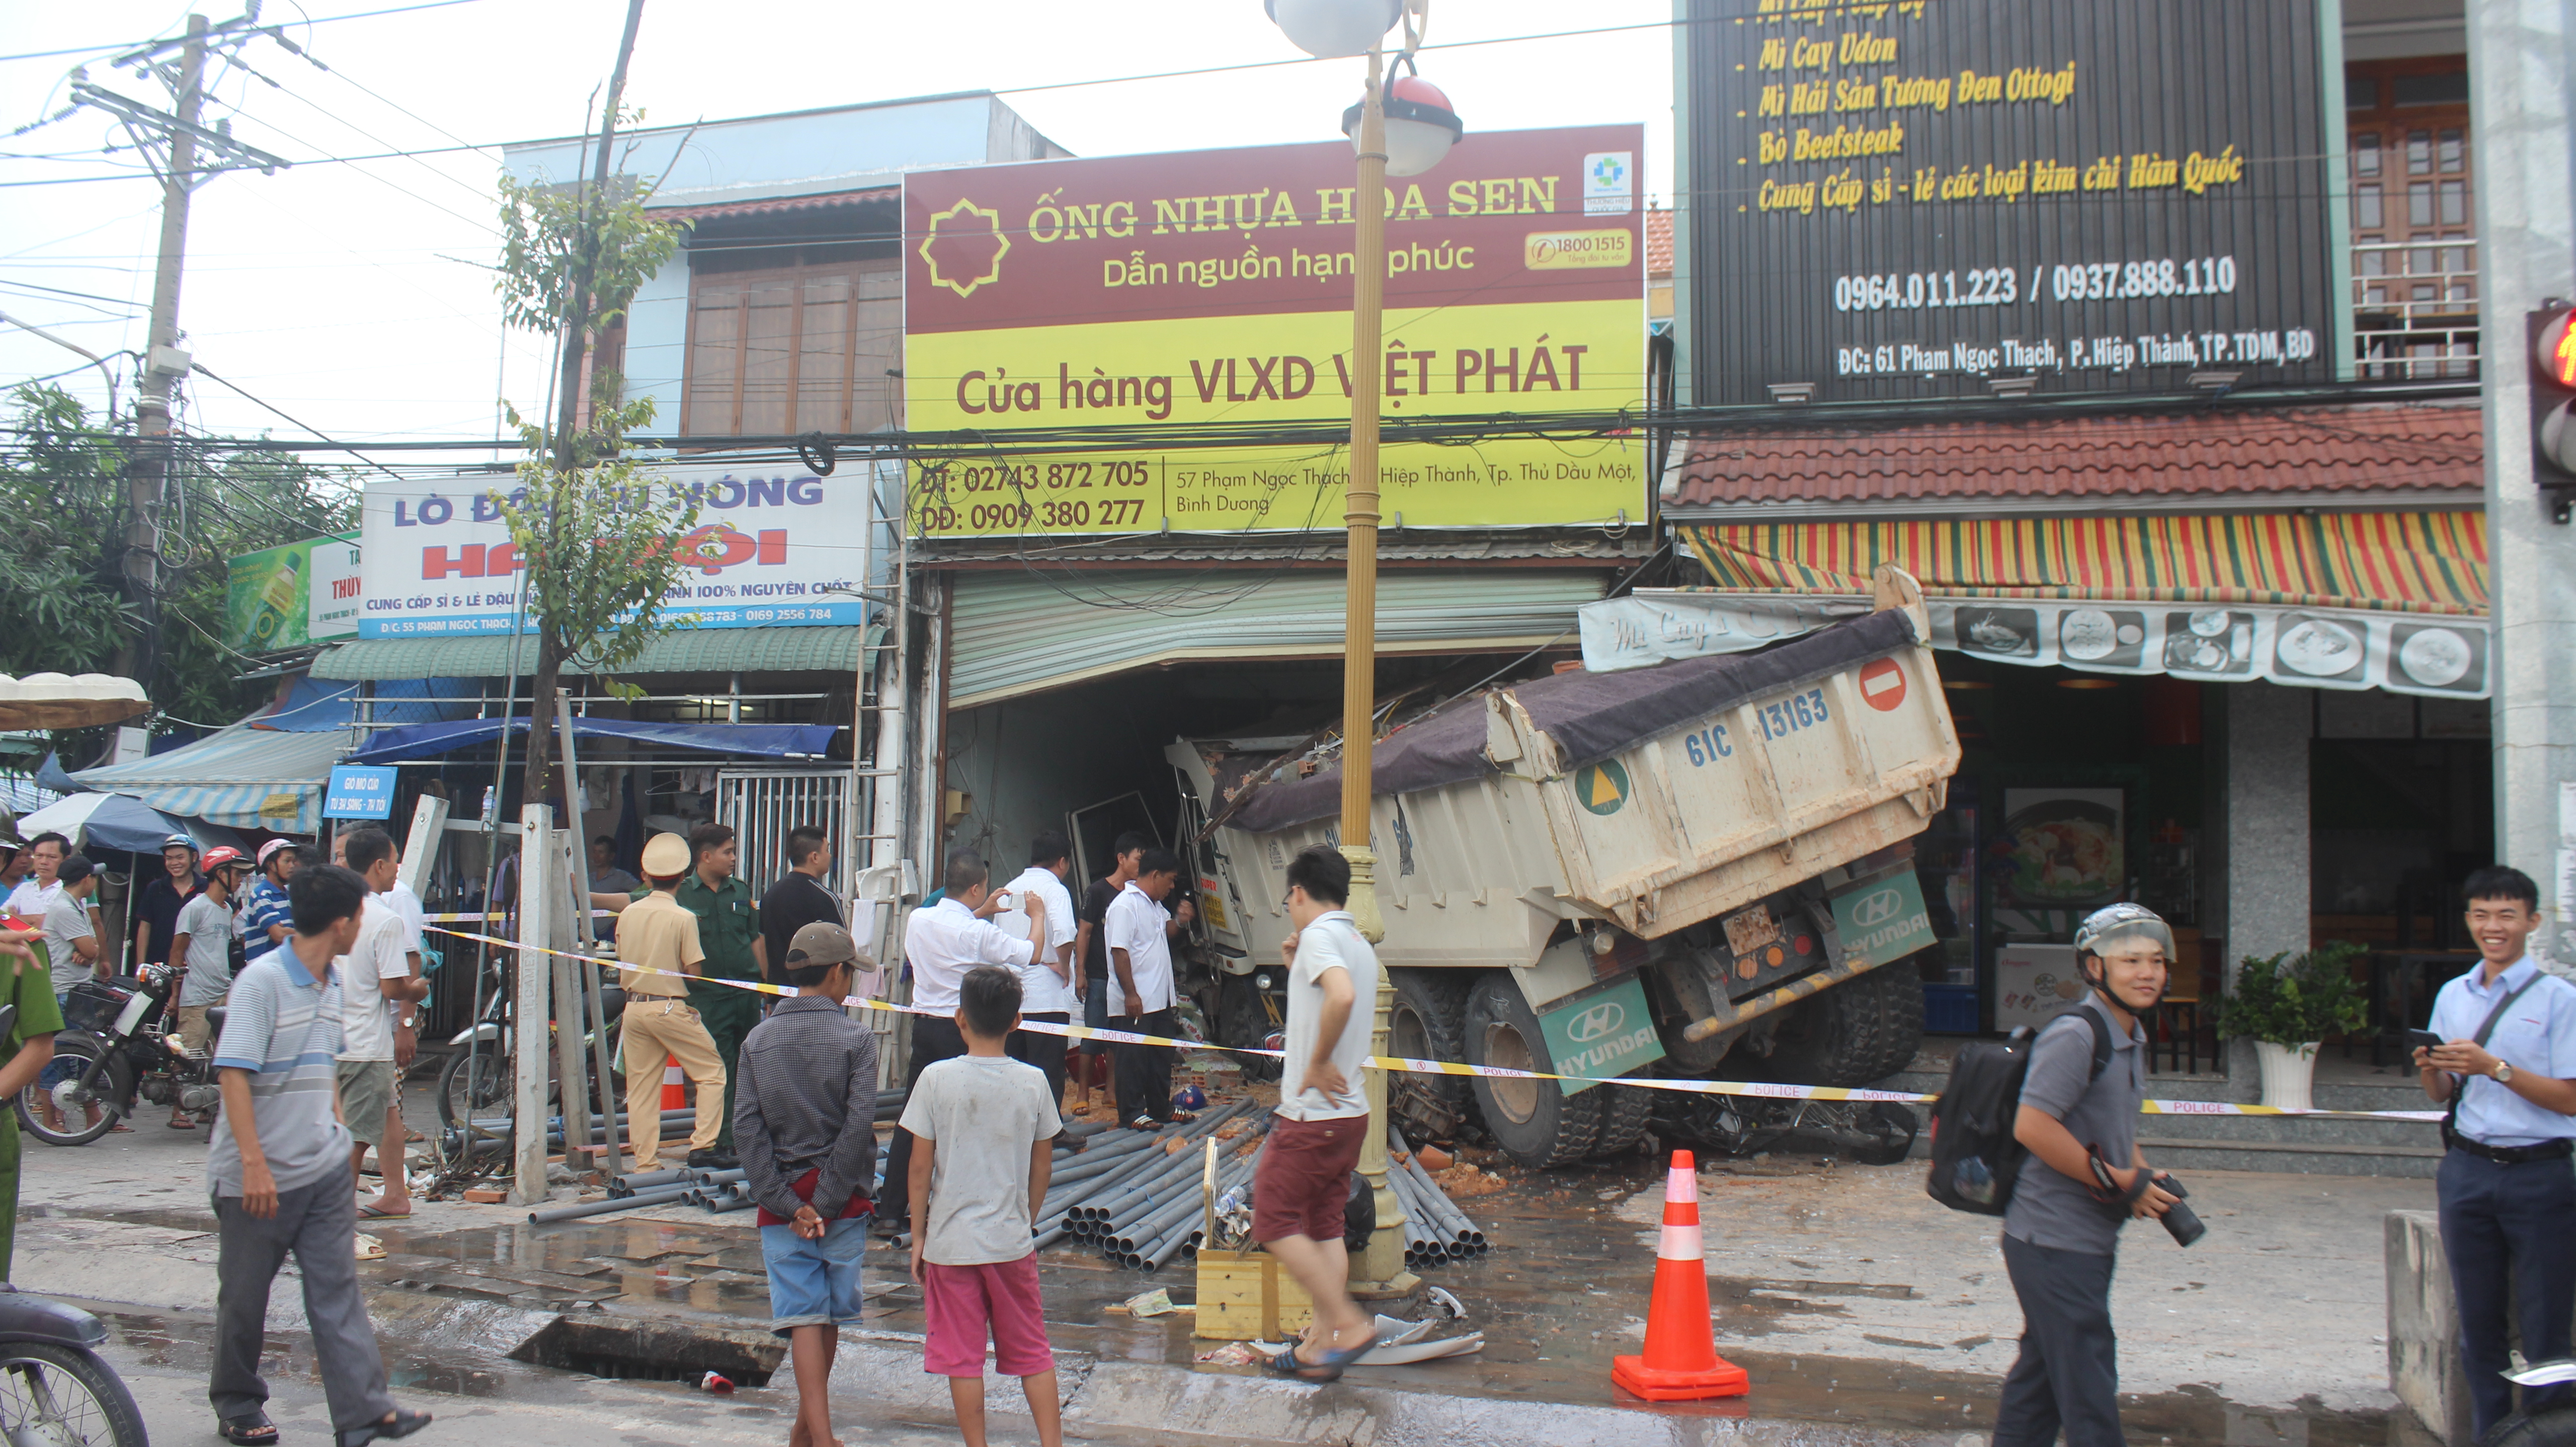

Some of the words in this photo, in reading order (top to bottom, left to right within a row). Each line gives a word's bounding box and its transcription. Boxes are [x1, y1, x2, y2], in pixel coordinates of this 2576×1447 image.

[1758, 37, 1786, 71] Mì
[1792, 36, 1834, 73] Cay
[1839, 31, 1898, 65] Udon
[1758, 82, 1785, 118] Mì
[1790, 80, 1829, 115] Hải
[1835, 76, 1876, 112] Sản
[1882, 75, 1951, 111] Tương
[1957, 69, 2002, 104] Đen
[2006, 60, 2075, 105] Ottogi
[1759, 128, 1787, 165] Bò
[1793, 120, 1904, 162] Beefsteak
[1759, 178, 1815, 215] Cung
[1822, 166, 1864, 213] Cấp
[1914, 165, 1936, 202] lẻ
[1941, 165, 1980, 201] các
[1984, 160, 2028, 203] loại
[2032, 158, 2077, 194] kim
[2084, 155, 2122, 191] chi
[2129, 152, 2177, 189] Hàn
[2183, 144, 2243, 194] Quốc
[1028, 187, 1138, 243] ỐNG
[1152, 187, 1302, 240] NHỰA
[1316, 184, 1433, 225] HA
[1448, 176, 1560, 218] SEN
[1104, 250, 1168, 287] Dẫn
[1178, 245, 1282, 288] nguồn
[1388, 240, 1474, 278] phúc
[1835, 266, 2017, 312] 0964.011.223
[2053, 254, 2236, 301] 0937.888.110
[957, 367, 1040, 414] Cửa
[1059, 362, 1172, 419] hàng
[1189, 356, 1314, 403] VLXD
[1456, 333, 1588, 394] PHÁT
[1839, 347, 1871, 376] ĐC:
[1875, 344, 1897, 373] 61
[1901, 344, 1949, 380] Phạm
[1953, 342, 1999, 377] Ngọc
[2002, 338, 2064, 375] Thạch,
[964, 464, 1039, 492] 02743
[1047, 463, 1092, 488] 872
[1102, 461, 1148, 487] 705
[1176, 472, 1196, 488] 57
[1203, 472, 1245, 490] Phạm
[1253, 469, 1297, 491] Ngọc
[1380, 467, 1419, 487] Hiệp
[1425, 465, 1481, 484] Thành,
[1488, 465, 1512, 485] Tp.
[1519, 462, 1548, 481] Thủ
[1556, 460, 1591, 480] Dầu
[1597, 461, 1636, 482] Một,
[395, 493, 453, 527] LÒ
[669, 475, 823, 511] NÓNG
[970, 501, 1032, 530] 0909
[1042, 499, 1090, 527] 380
[1098, 499, 1144, 525] 277
[1176, 495, 1210, 513] Bình
[1216, 495, 1269, 515] Dương
[332, 574, 361, 599] THÙY
[366, 598, 402, 610] CUNG
[406, 594, 432, 609] CẤP
[452, 597, 463, 607] &
[466, 591, 481, 606] LẺ
[740, 581, 806, 597] NGUYÊN
[402, 619, 414, 632] 55
[417, 619, 447, 634] PHẠM
[449, 618, 479, 632] NGỌC
[746, 610, 774, 622] 0169
[777, 609, 807, 621] 2556
[809, 608, 832, 619] 784
[1685, 724, 1732, 768] 61C
[1757, 688, 1829, 741] 13163
[1200, 877, 1217, 892] SUPER
[1556, 1025, 1659, 1077] HYUNDAI
[2173, 1102, 2226, 1113] POLICE
